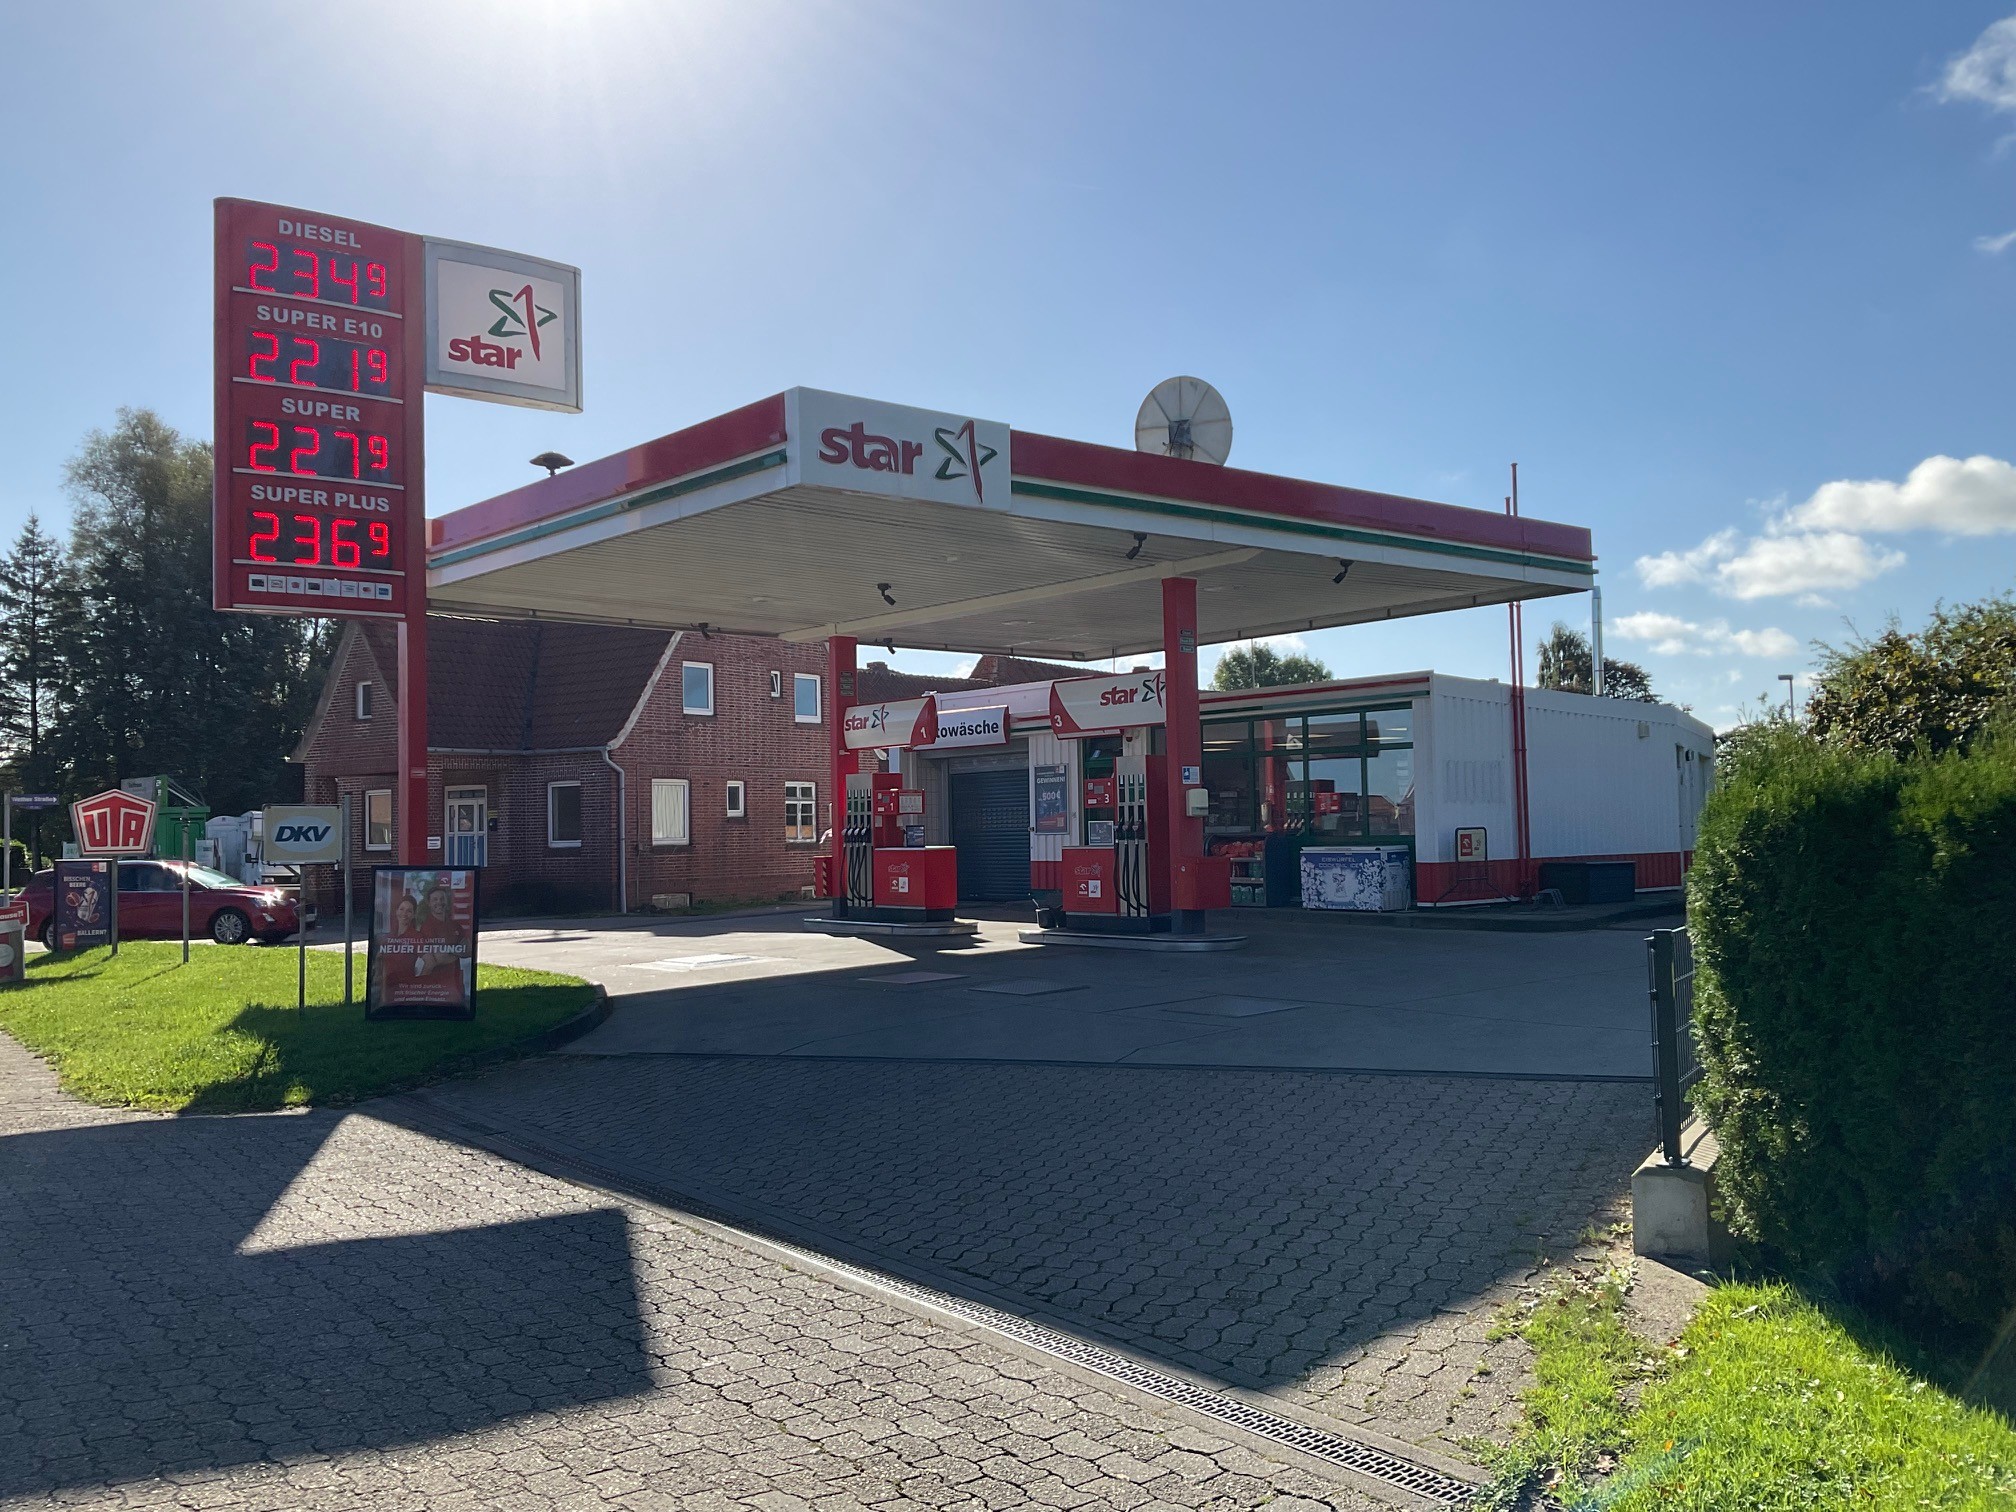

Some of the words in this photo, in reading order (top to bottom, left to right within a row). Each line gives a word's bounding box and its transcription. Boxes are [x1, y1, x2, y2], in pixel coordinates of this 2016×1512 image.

[278, 219, 361, 248] DIESEL
[256, 305, 337, 331] SUPER
[344, 318, 383, 339] E10
[448, 335, 522, 370] star
[281, 398, 360, 421] SUPER
[818, 421, 922, 474] star
[251, 484, 328, 506] SUPER
[334, 492, 390, 512] PLUS
[1100, 686, 1138, 706] star
[844, 714, 869, 731] star
[937, 720, 999, 738] owäsche
[1054, 714, 1063, 727] 3
[920, 726, 928, 739] 1
[890, 802, 894, 811] 1
[1104, 794, 1110, 803] 3
[82, 797, 148, 847] UTA
[274, 825, 331, 842] DKV
[380, 944, 414, 954] NEUER
[417, 944, 466, 954] LEITUNG!
